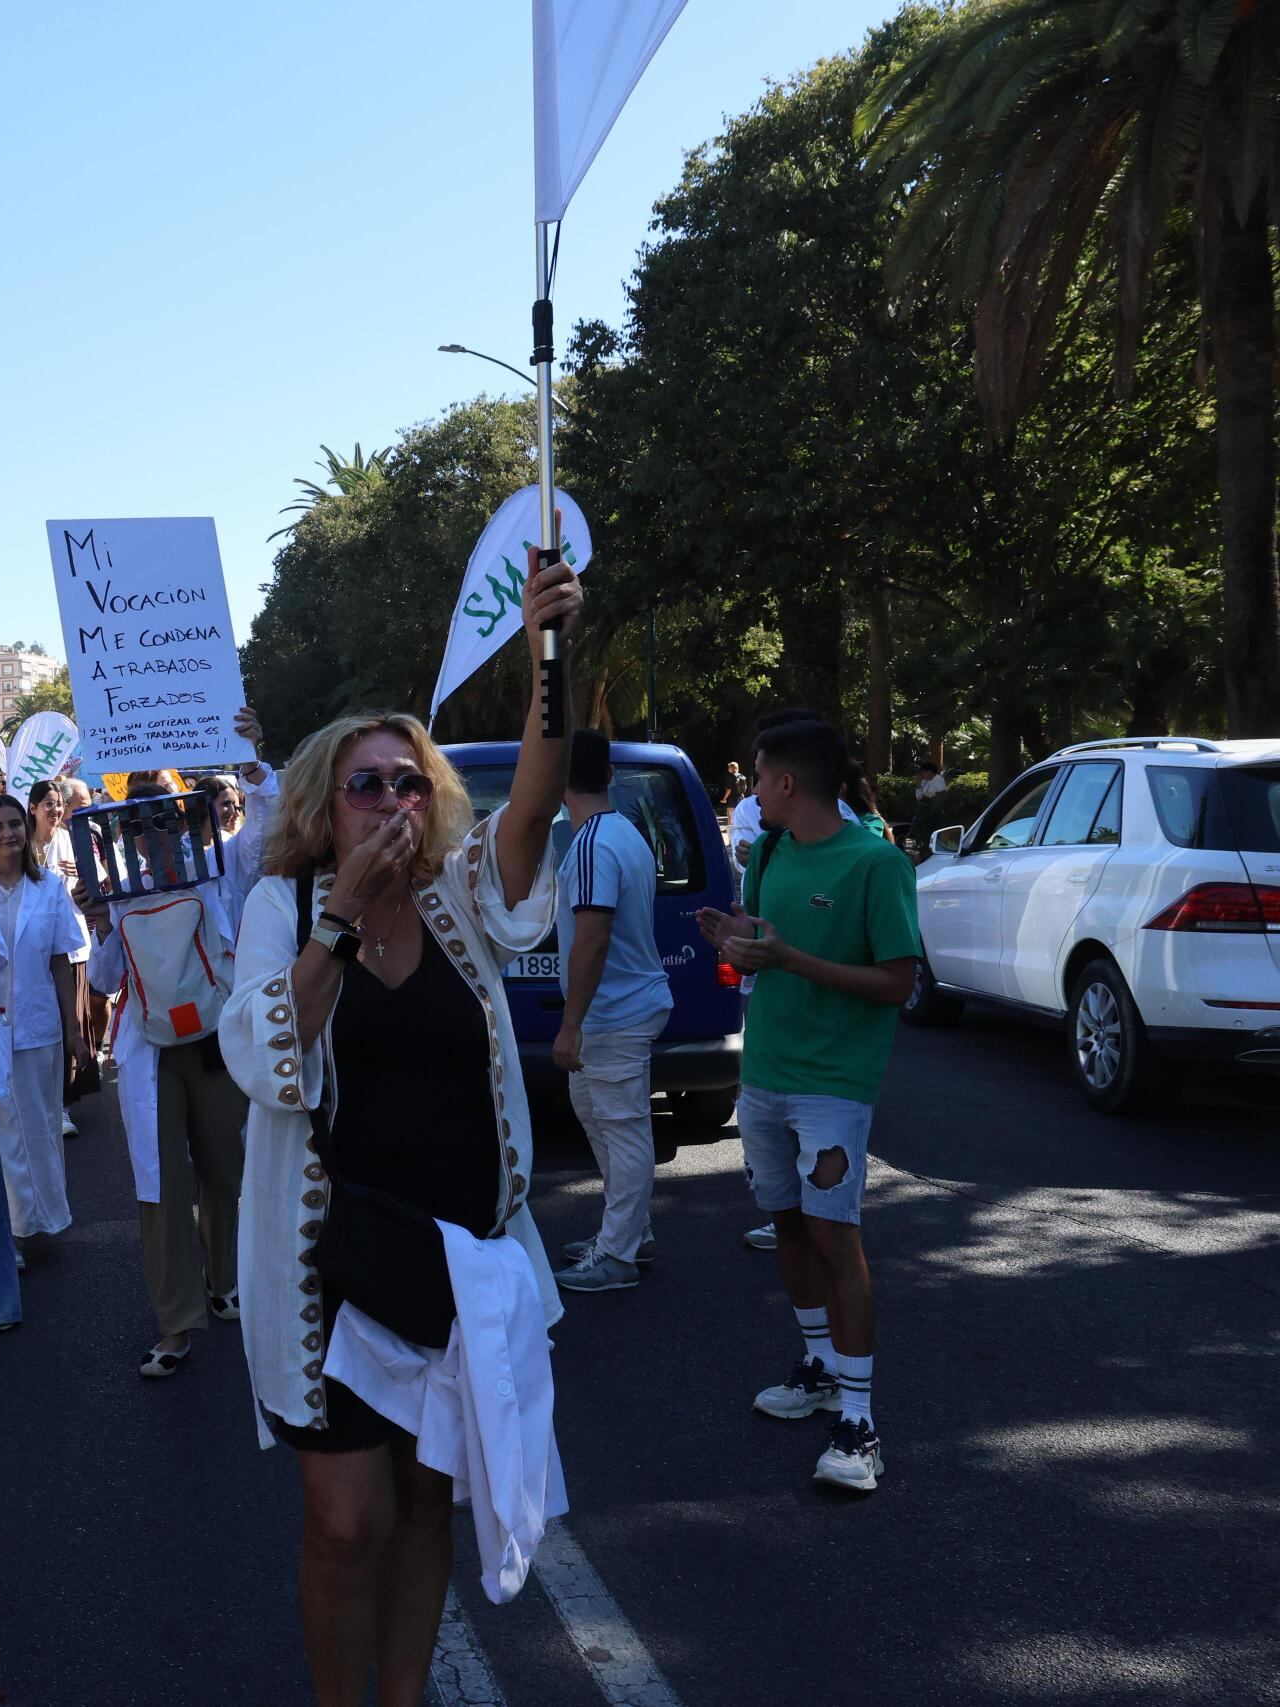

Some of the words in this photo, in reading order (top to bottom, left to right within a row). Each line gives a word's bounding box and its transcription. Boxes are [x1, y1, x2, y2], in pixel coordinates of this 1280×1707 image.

[139, 625, 221, 648] CONDENA
[90, 660, 107, 681] A
[112, 658, 213, 679] TRABAJOS
[103, 686, 207, 718] FORZADOS
[197, 715, 221, 724] COMO
[144, 729, 199, 740] TRABAJADO
